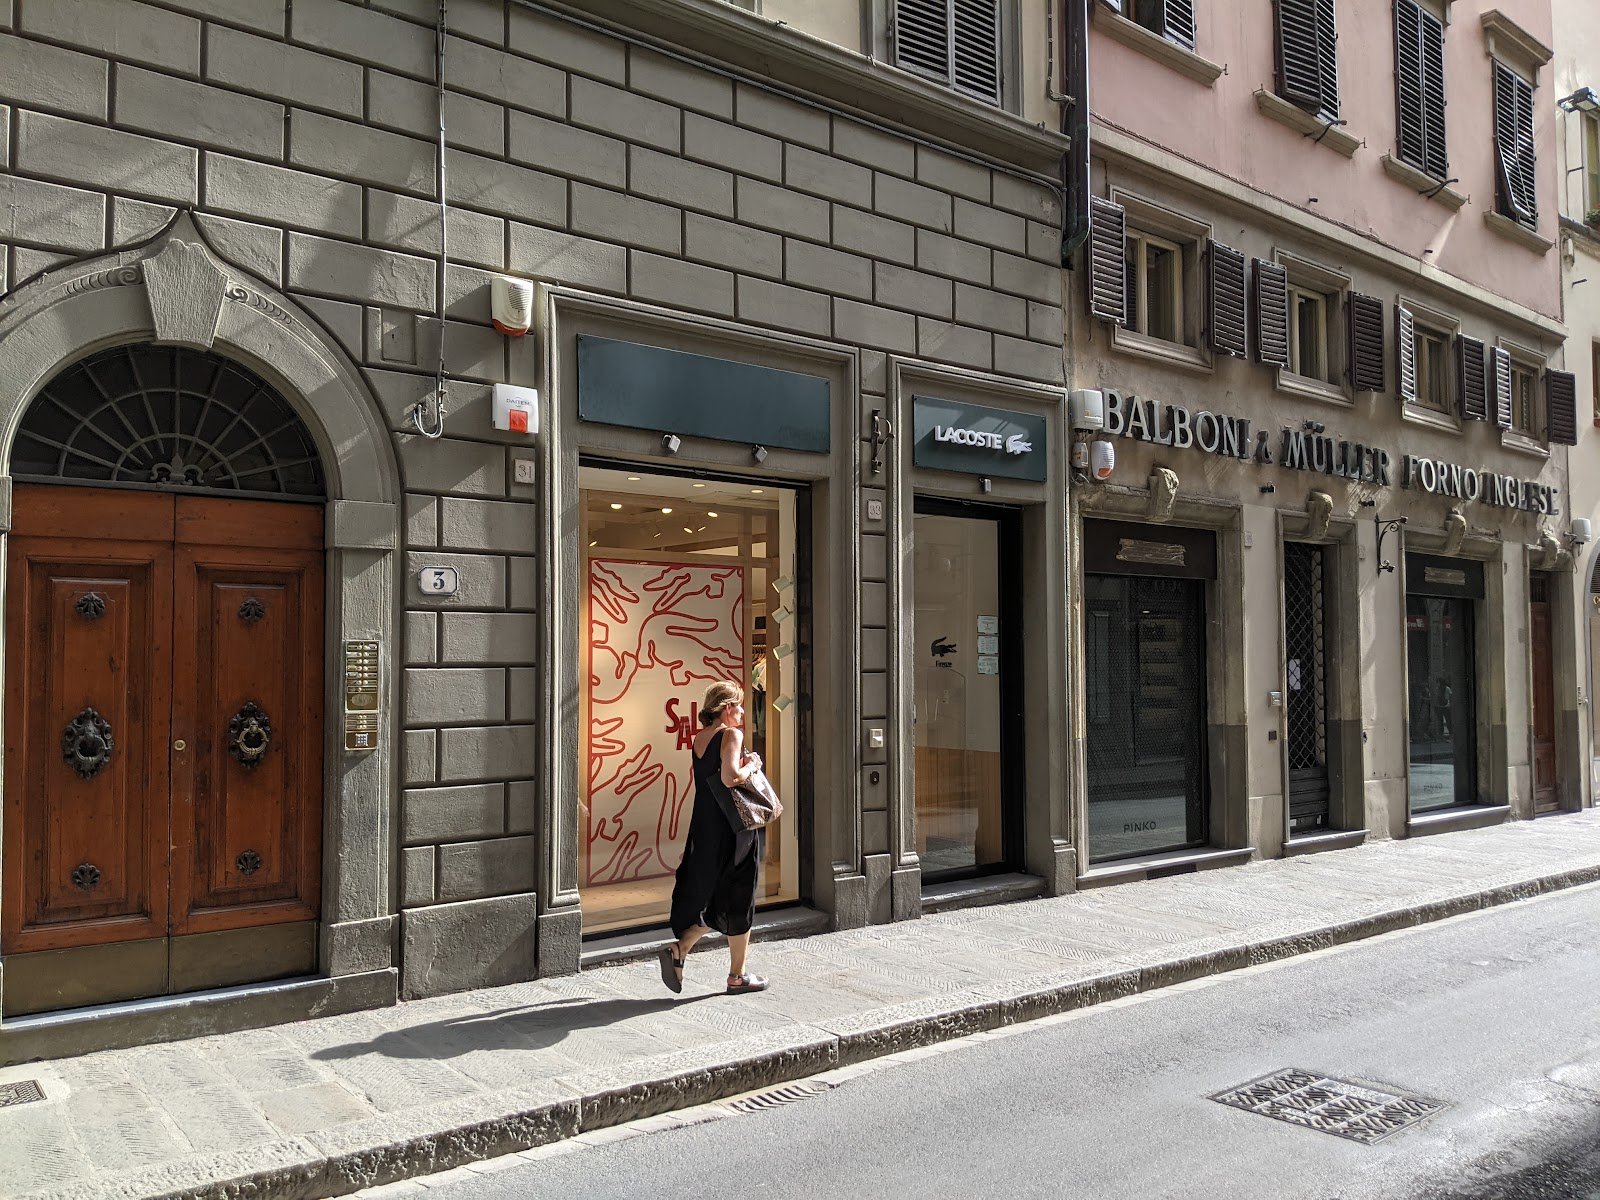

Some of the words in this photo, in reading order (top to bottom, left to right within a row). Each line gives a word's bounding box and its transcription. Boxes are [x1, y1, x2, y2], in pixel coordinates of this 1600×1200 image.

[934, 425, 1003, 450] LACOSTE
[1102, 388, 1251, 459] BALBONI
[1254, 430, 1273, 464] &
[1400, 454, 1478, 501] FORNO
[1479, 472, 1559, 515] INGLESE
[433, 571, 445, 590] 3
[665, 697, 704, 751] SAL
[1123, 821, 1157, 834] PINKO
